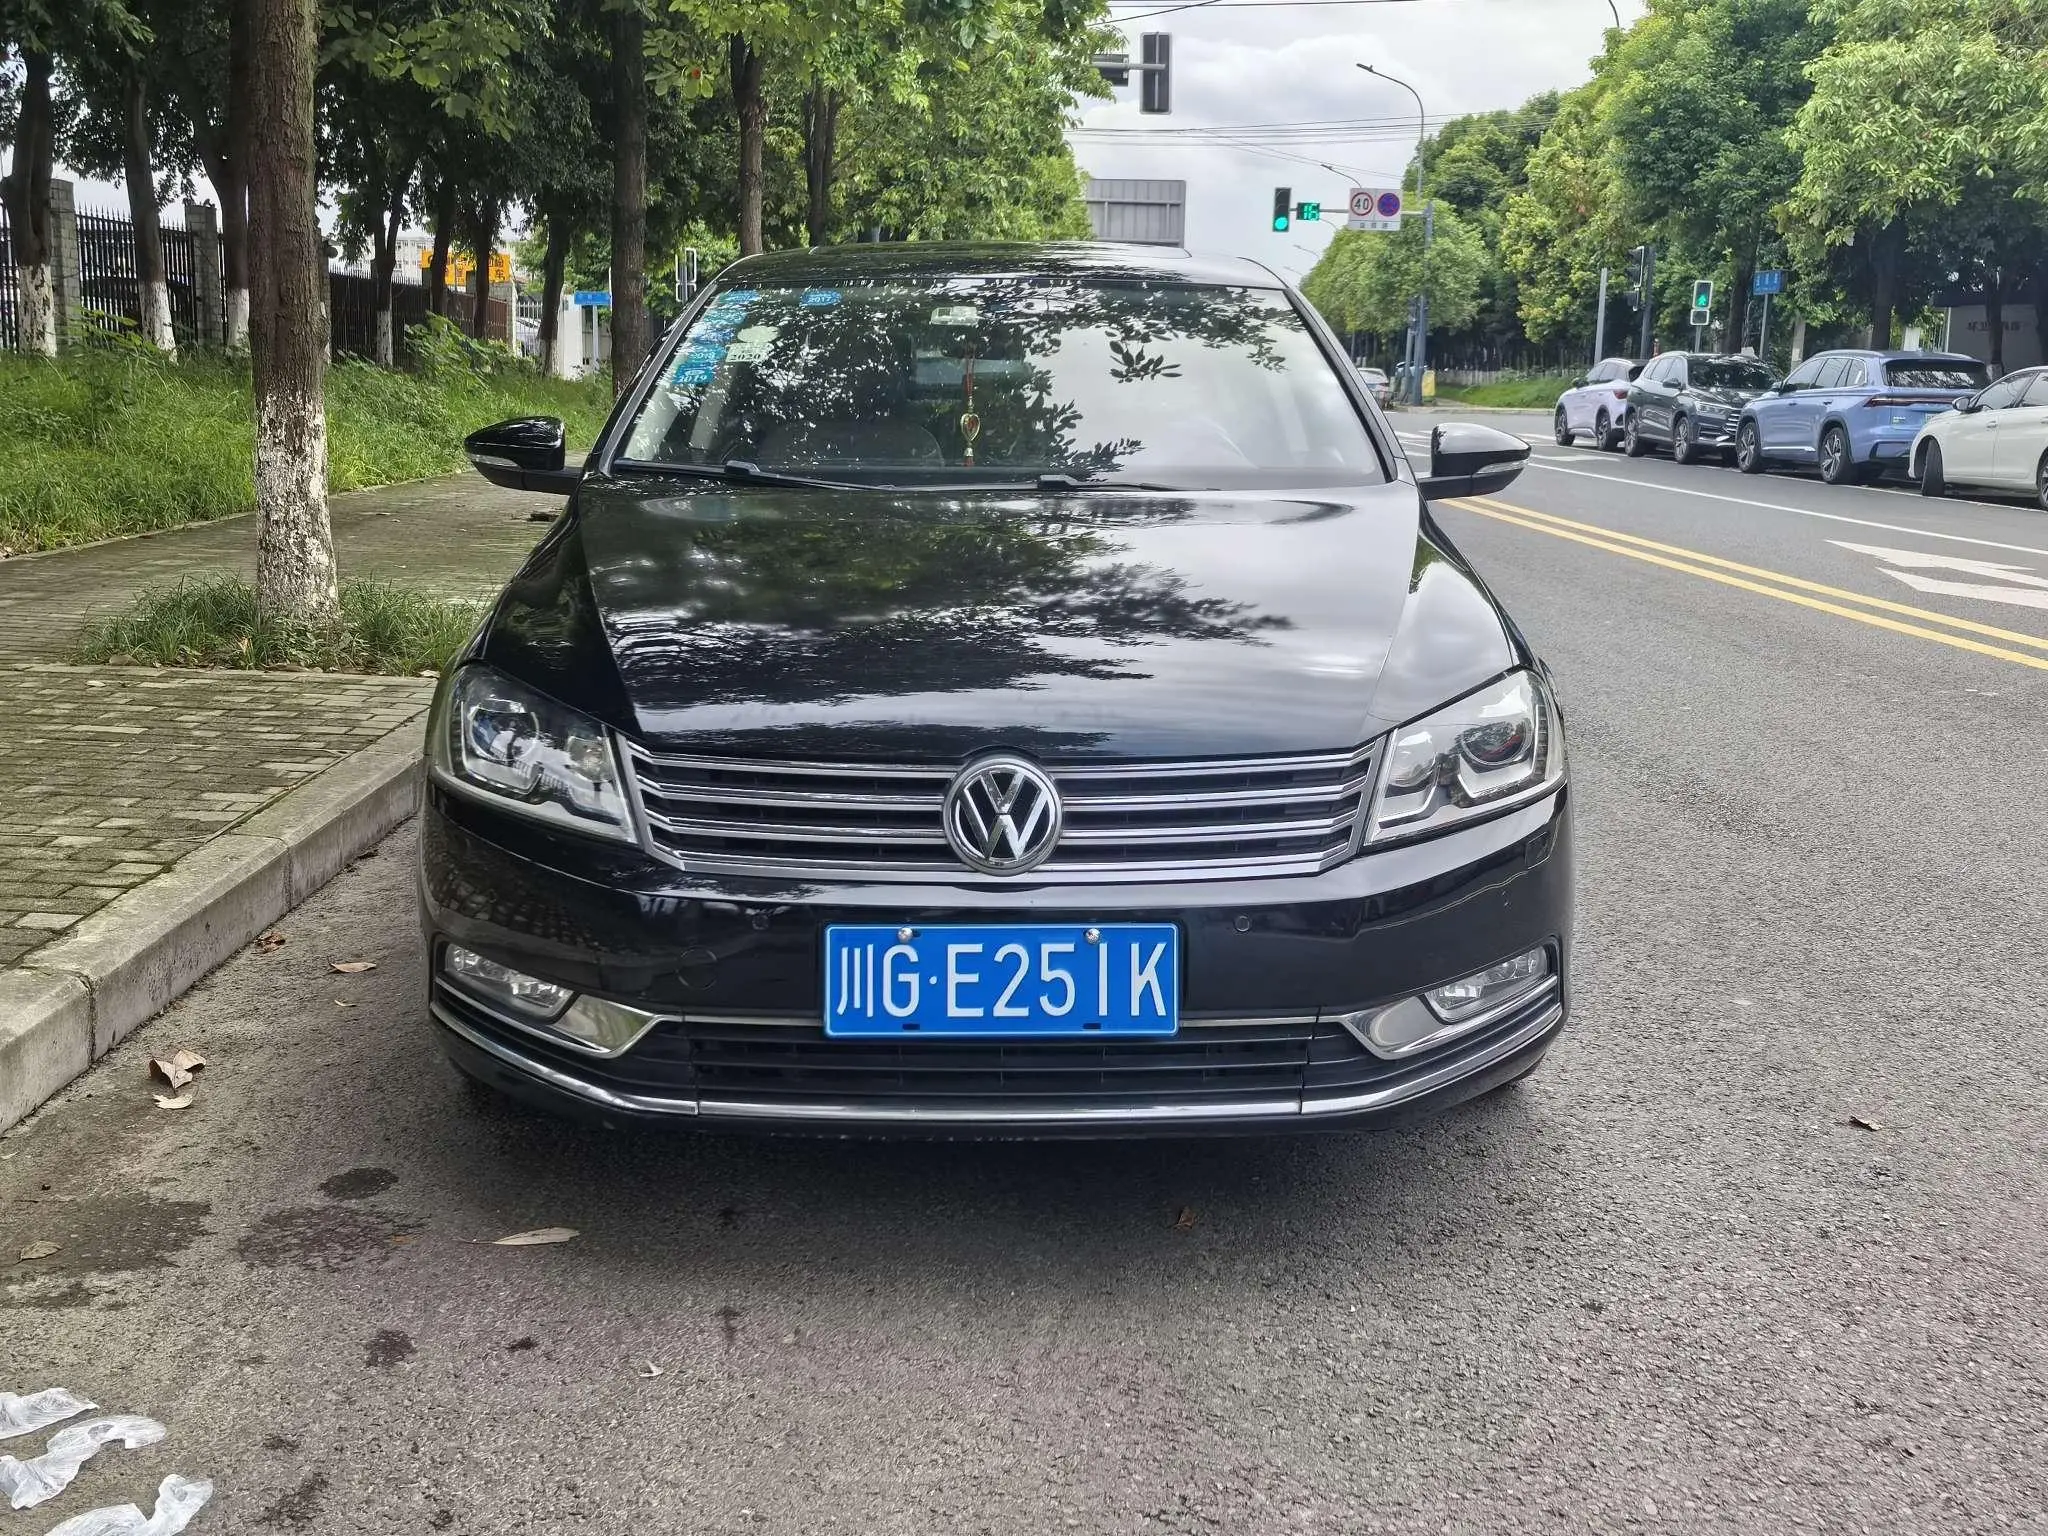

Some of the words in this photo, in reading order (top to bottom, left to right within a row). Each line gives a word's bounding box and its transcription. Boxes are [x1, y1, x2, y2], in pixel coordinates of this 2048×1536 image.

[1354, 197, 1370, 211] 40
[1303, 203, 1319, 221] 16
[730, 353, 761, 361] 2020
